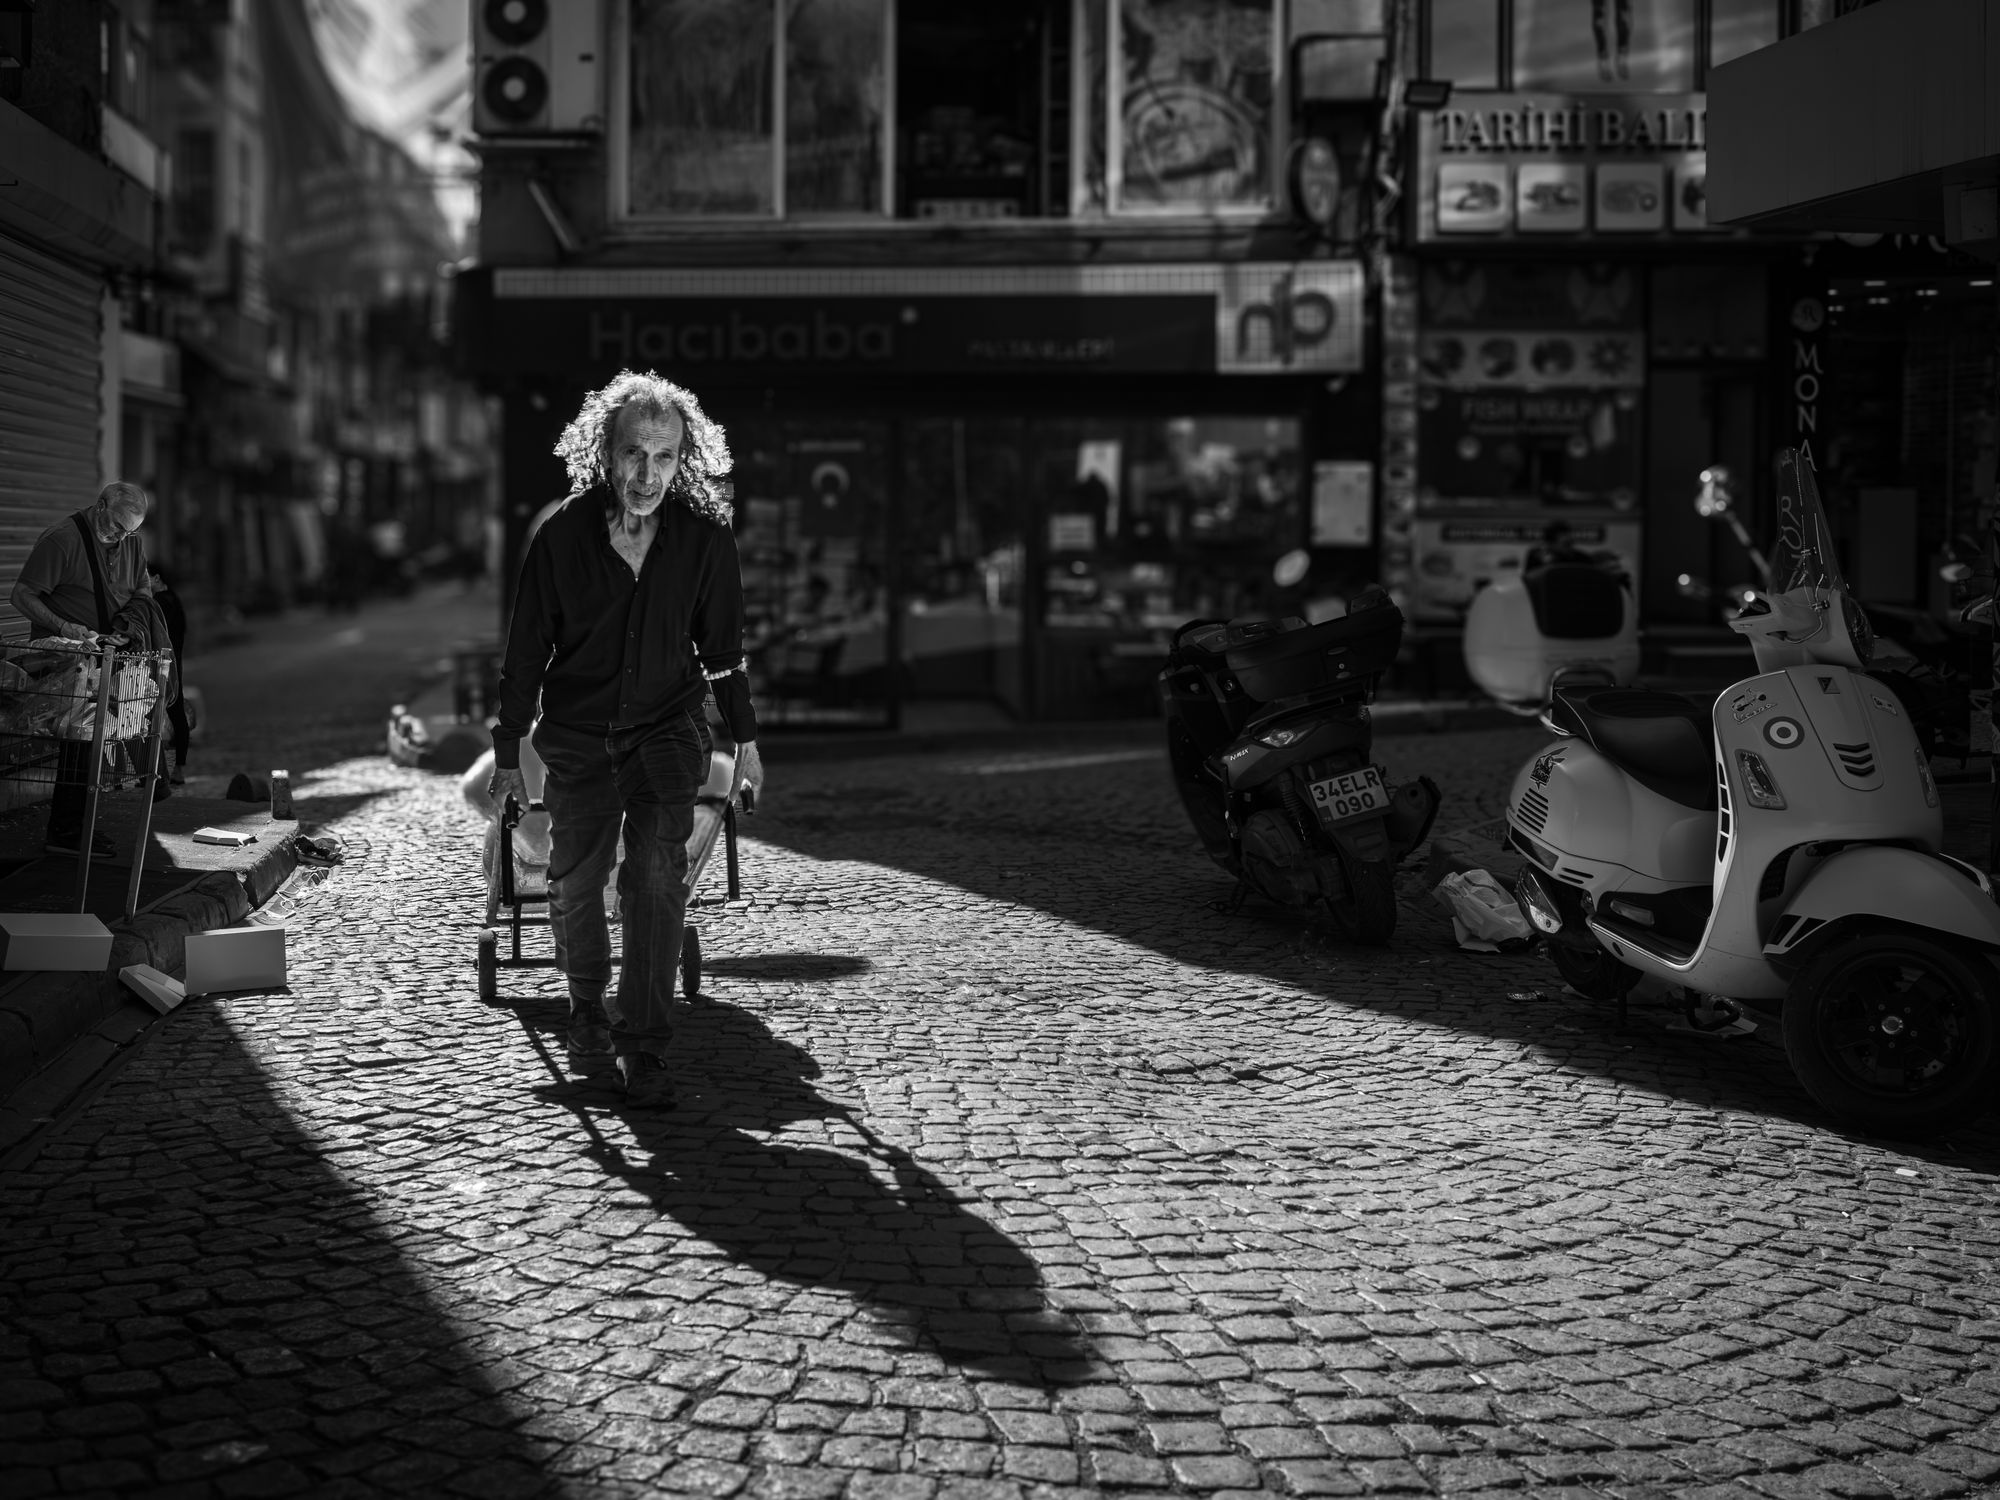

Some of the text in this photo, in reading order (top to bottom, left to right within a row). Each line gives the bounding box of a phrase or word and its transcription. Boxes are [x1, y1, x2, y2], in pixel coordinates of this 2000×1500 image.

[1438, 101, 1707, 149] TARİHİ BALI
[588, 307, 893, 361] Hacıbaba
[1313, 770, 1380, 802] 34ELR
[1335, 792, 1376, 816] 090
